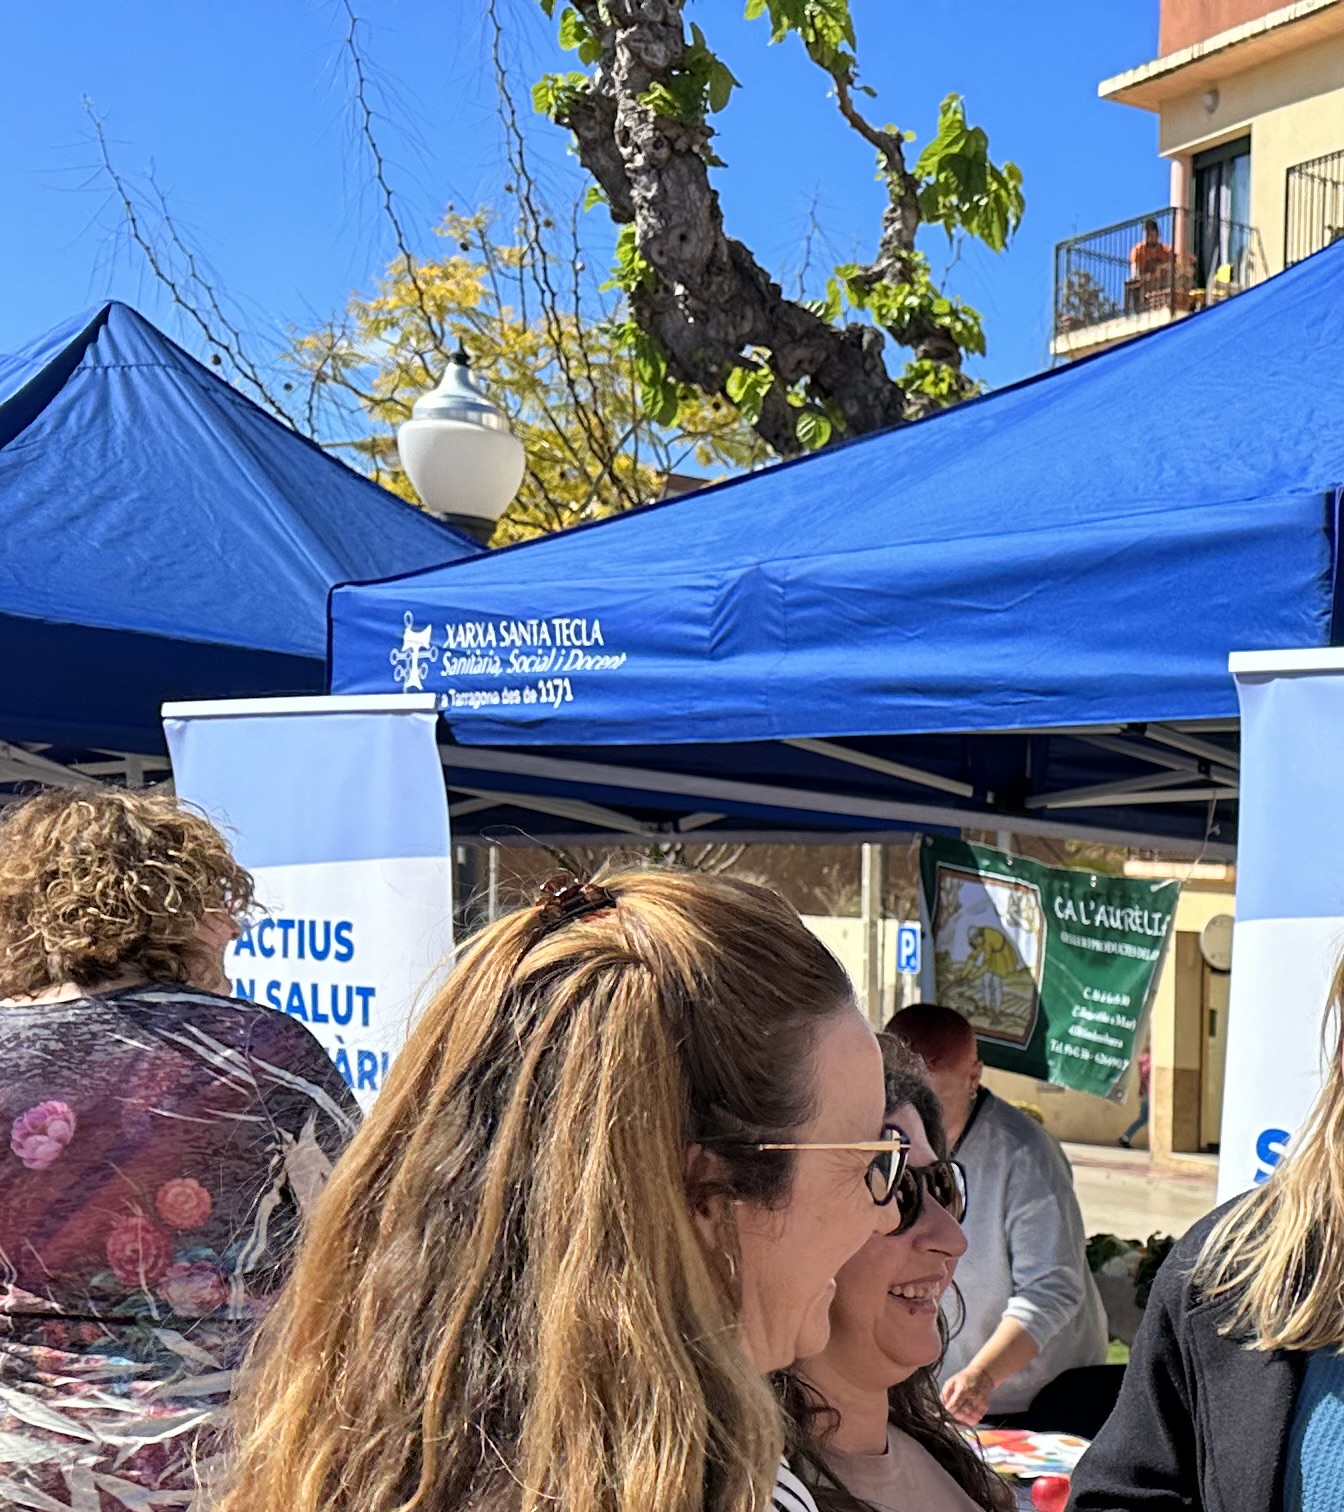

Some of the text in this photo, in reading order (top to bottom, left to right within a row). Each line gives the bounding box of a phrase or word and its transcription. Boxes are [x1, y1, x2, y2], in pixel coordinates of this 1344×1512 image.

[443, 618, 604, 648] XARXA SANTA TECLA
[506, 648, 556, 674] Social
[554, 650, 565, 671] i
[562, 649, 627, 671] Docent
[449, 688, 500, 709] Tarragona
[502, 687, 521, 705] des
[523, 686, 538, 704] de
[537, 678, 574, 709] 1171
[233, 917, 355, 962] ACTIUS
[266, 980, 376, 1027] SALUT
